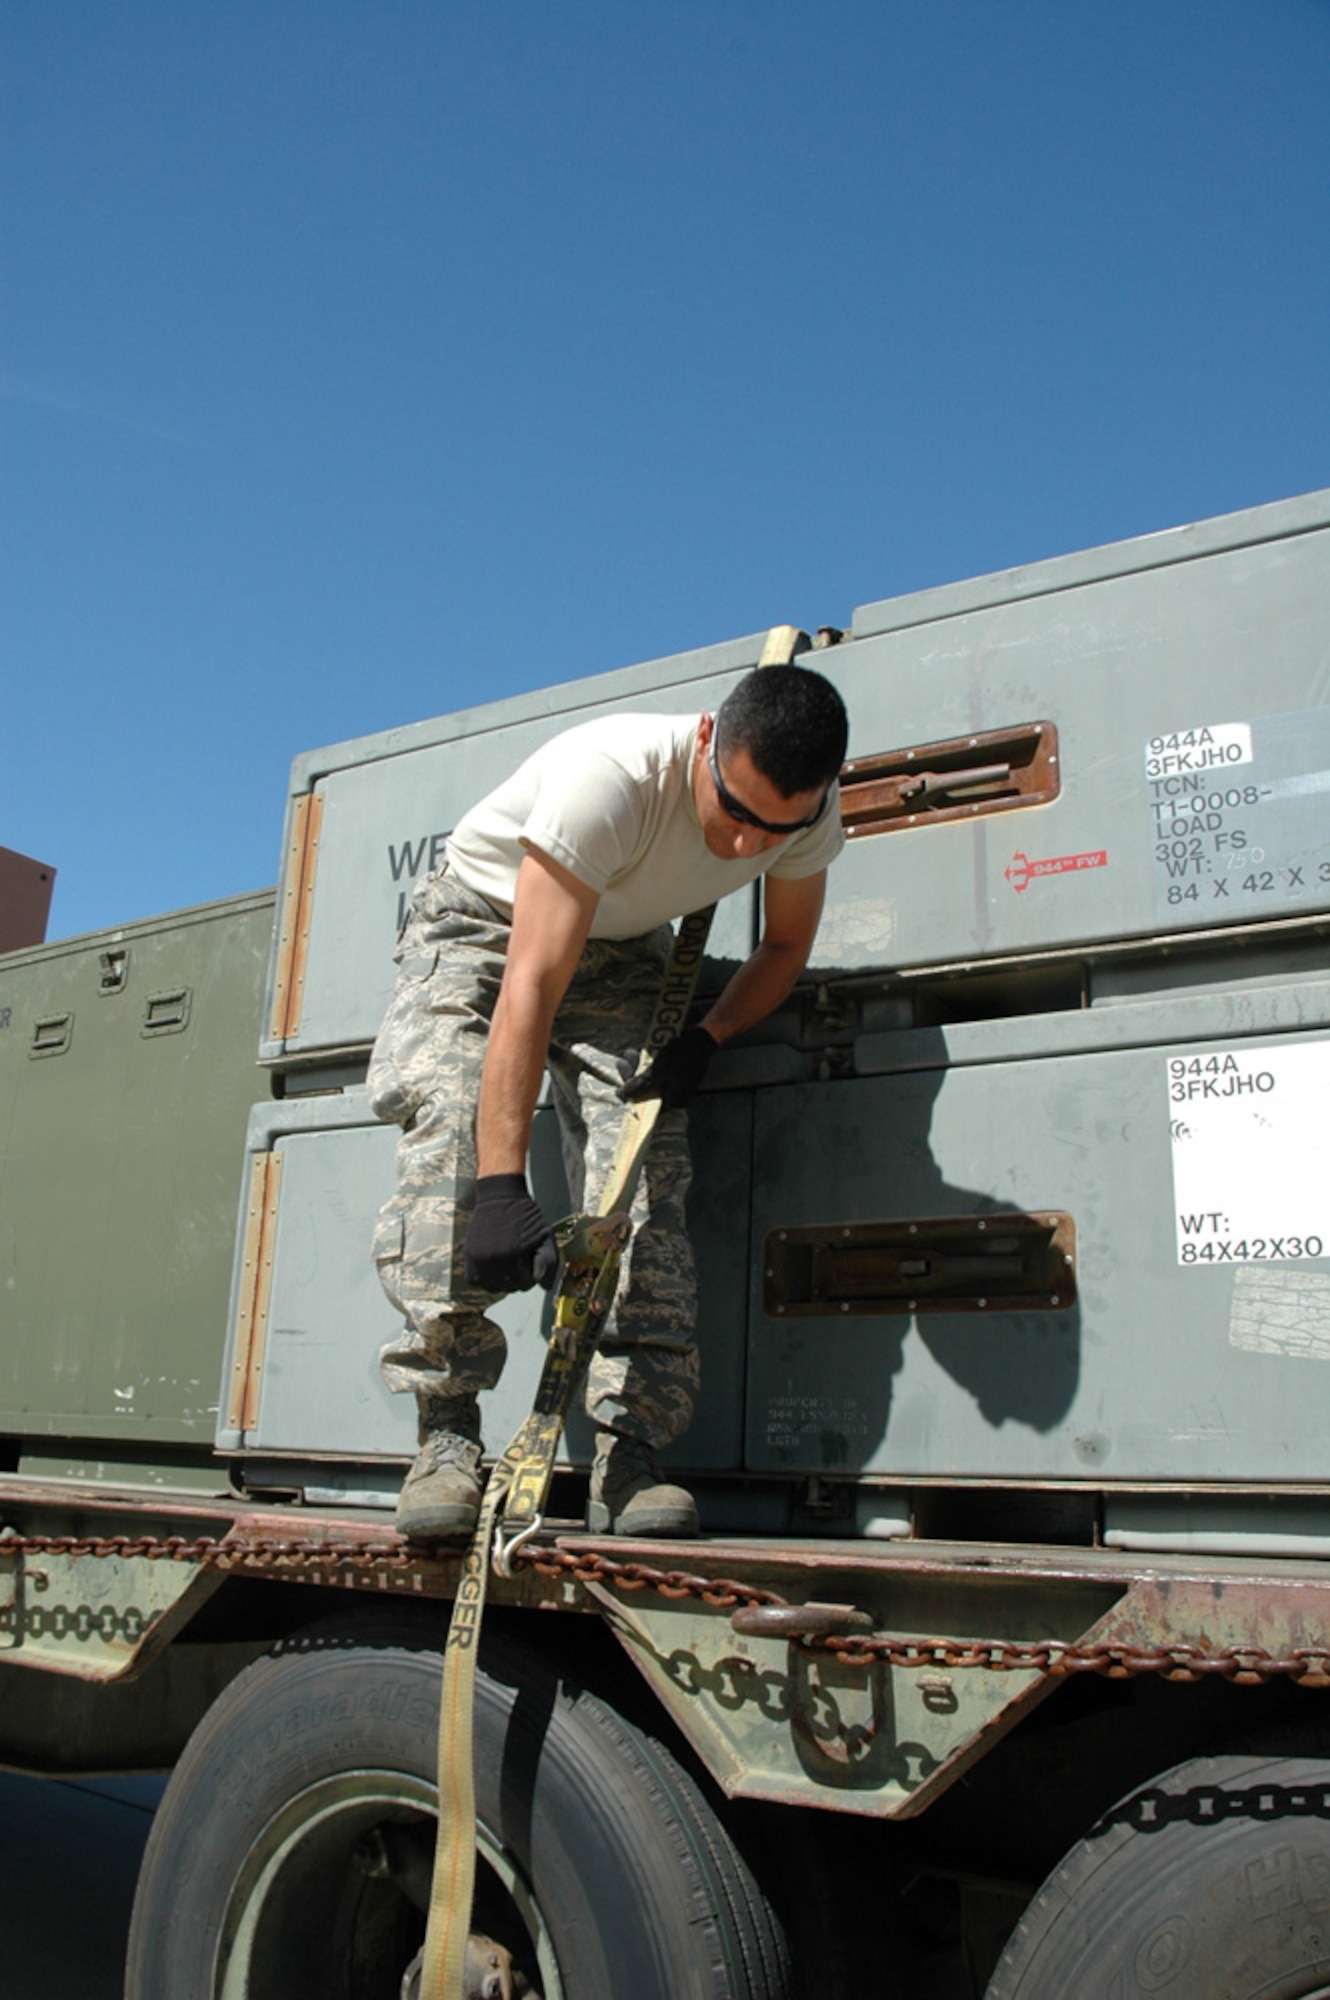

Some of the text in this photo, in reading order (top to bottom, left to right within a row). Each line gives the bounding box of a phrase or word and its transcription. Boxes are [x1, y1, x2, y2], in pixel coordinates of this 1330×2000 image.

[1150, 728, 1214, 755] 944A
[1150, 774, 1205, 798] TCN:
[1151, 786, 1272, 820] T1-0008-
[1157, 813, 1223, 840] LOAD
[1156, 830, 1247, 862] 302 FS
[1166, 857, 1212, 878] WT:
[1167, 883, 1198, 904] 84
[1214, 878, 1230, 898] X
[1242, 871, 1274, 892] 42
[1288, 867, 1305, 886] X
[1170, 1054, 1239, 1079] 944A
[1180, 1212, 1230, 1234] WT:
[1181, 1236, 1323, 1263] 84X42X30
